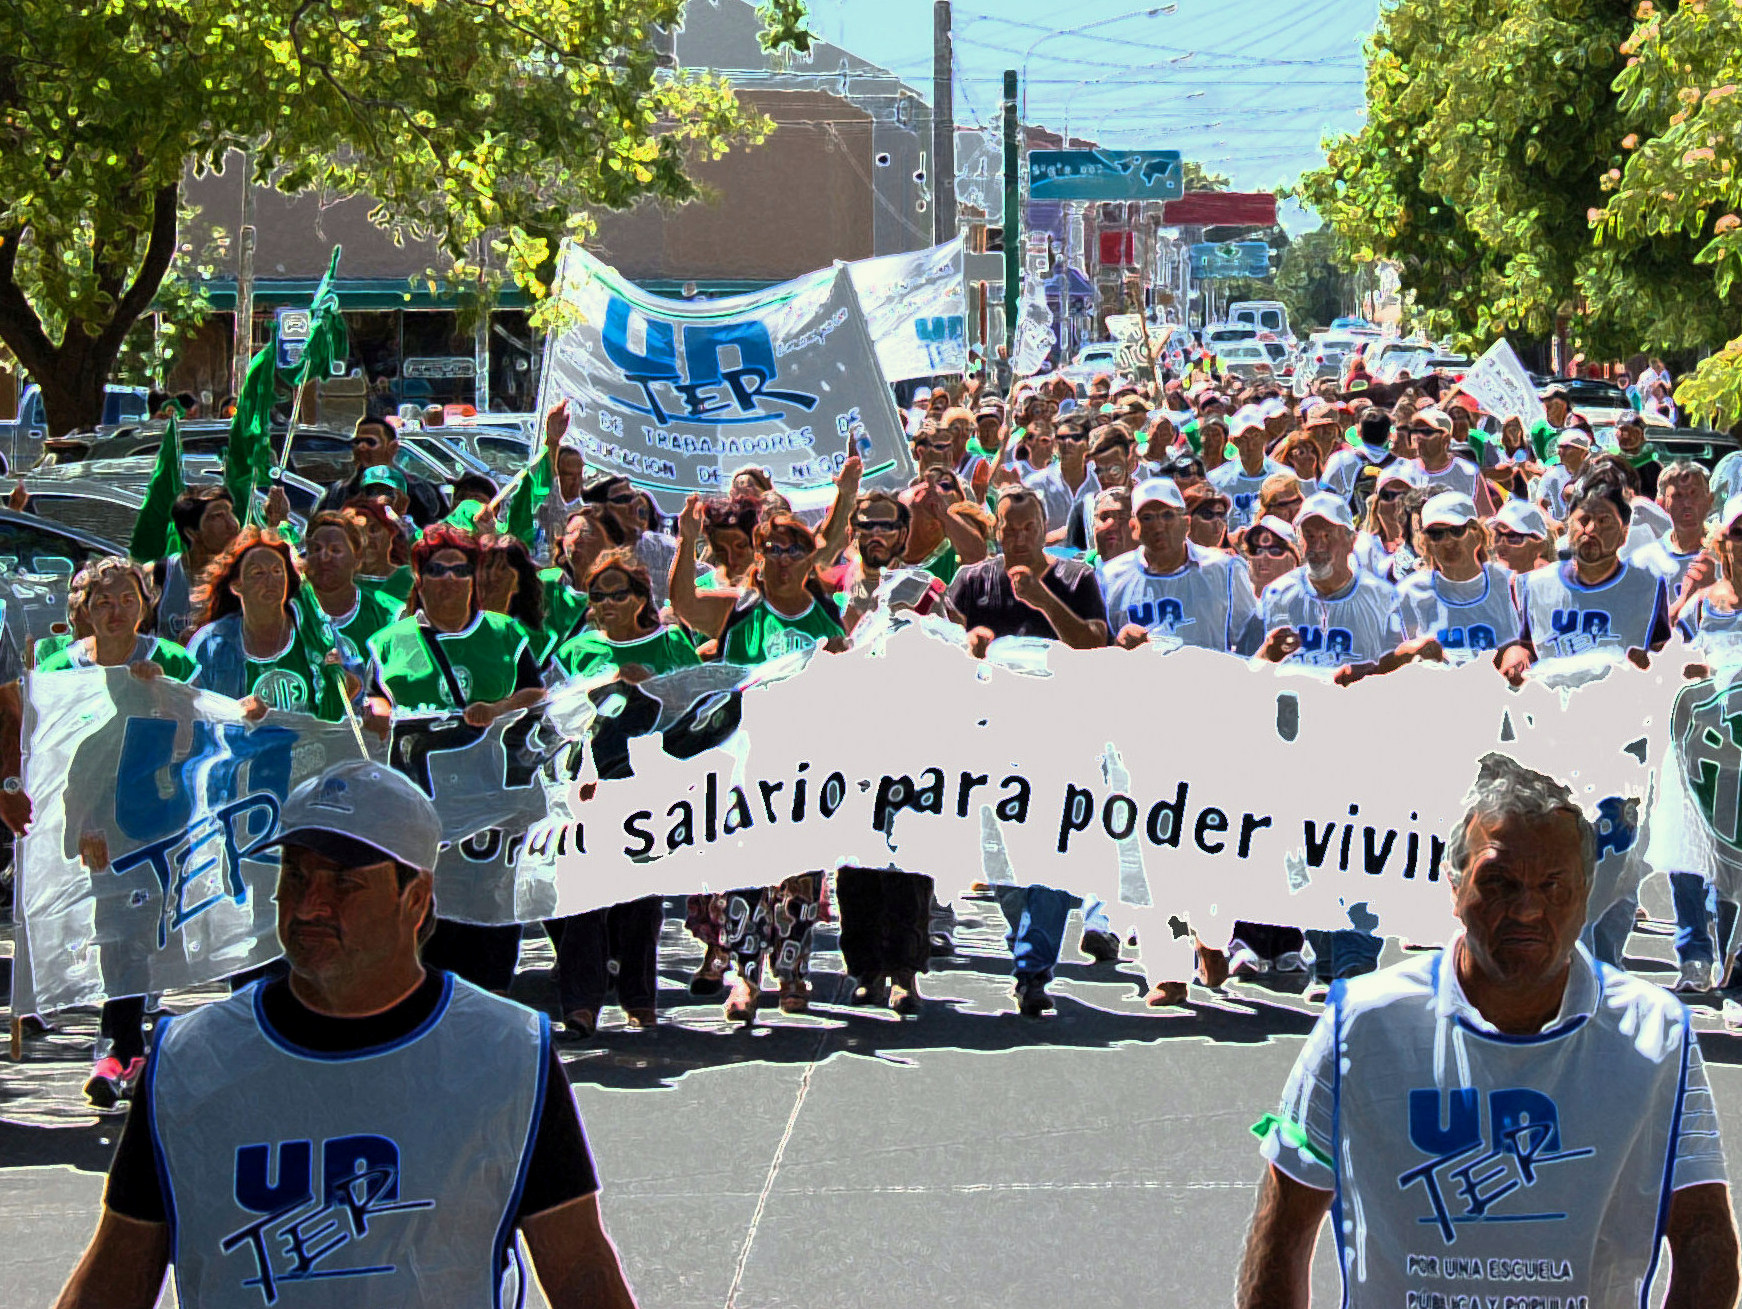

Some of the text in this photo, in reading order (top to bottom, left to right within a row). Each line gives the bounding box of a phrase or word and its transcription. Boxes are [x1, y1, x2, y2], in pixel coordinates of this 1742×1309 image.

[622, 366, 819, 425] TER
[641, 426, 815, 455] TRABAJADORES
[622, 762, 846, 858] salario
[872, 767, 1031, 834] para
[1057, 781, 1272, 859] poder
[1400, 1123, 1595, 1243] TER
[220, 1168, 435, 1306] TER
[1407, 1255, 1573, 1282] POR UNA ESCUELA
